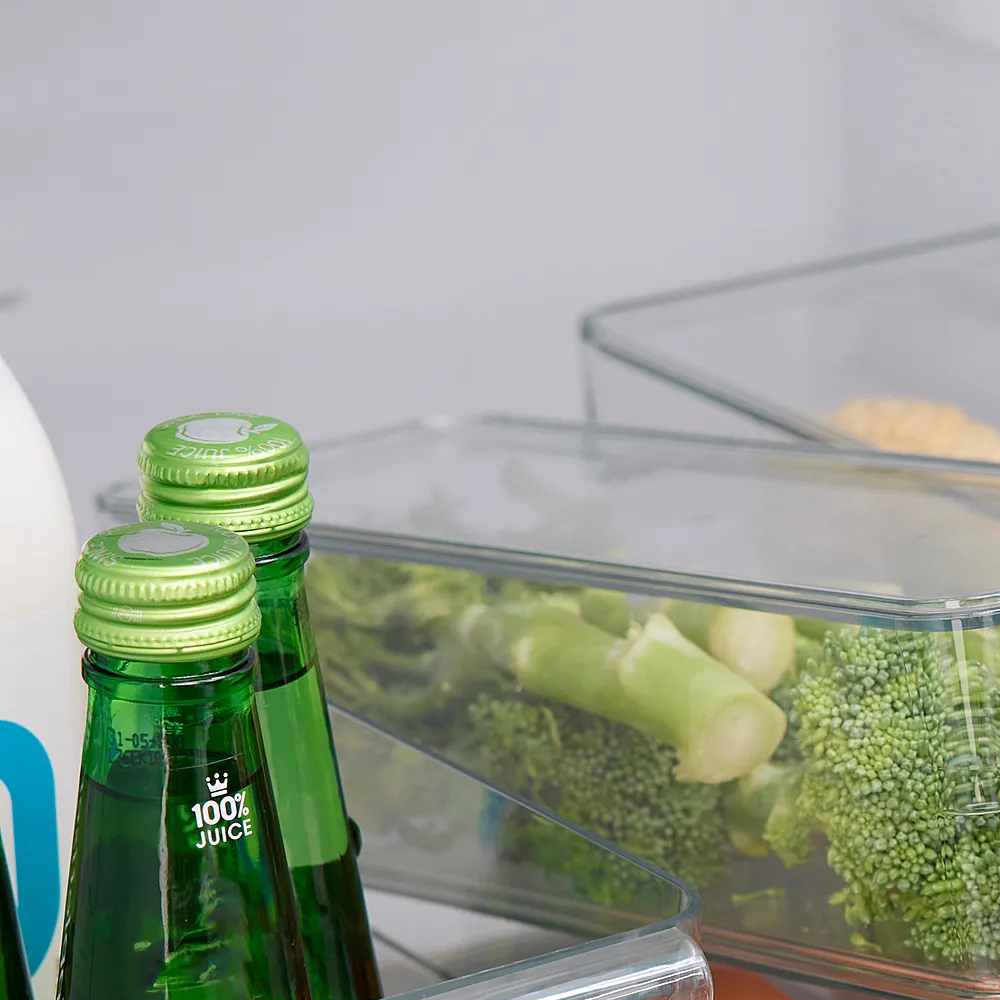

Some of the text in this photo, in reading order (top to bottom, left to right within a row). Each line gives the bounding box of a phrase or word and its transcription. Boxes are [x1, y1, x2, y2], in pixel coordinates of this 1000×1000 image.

[165, 443, 230, 460] JUICE
[191, 791, 249, 828] 100%
[195, 818, 253, 849] JUICE
